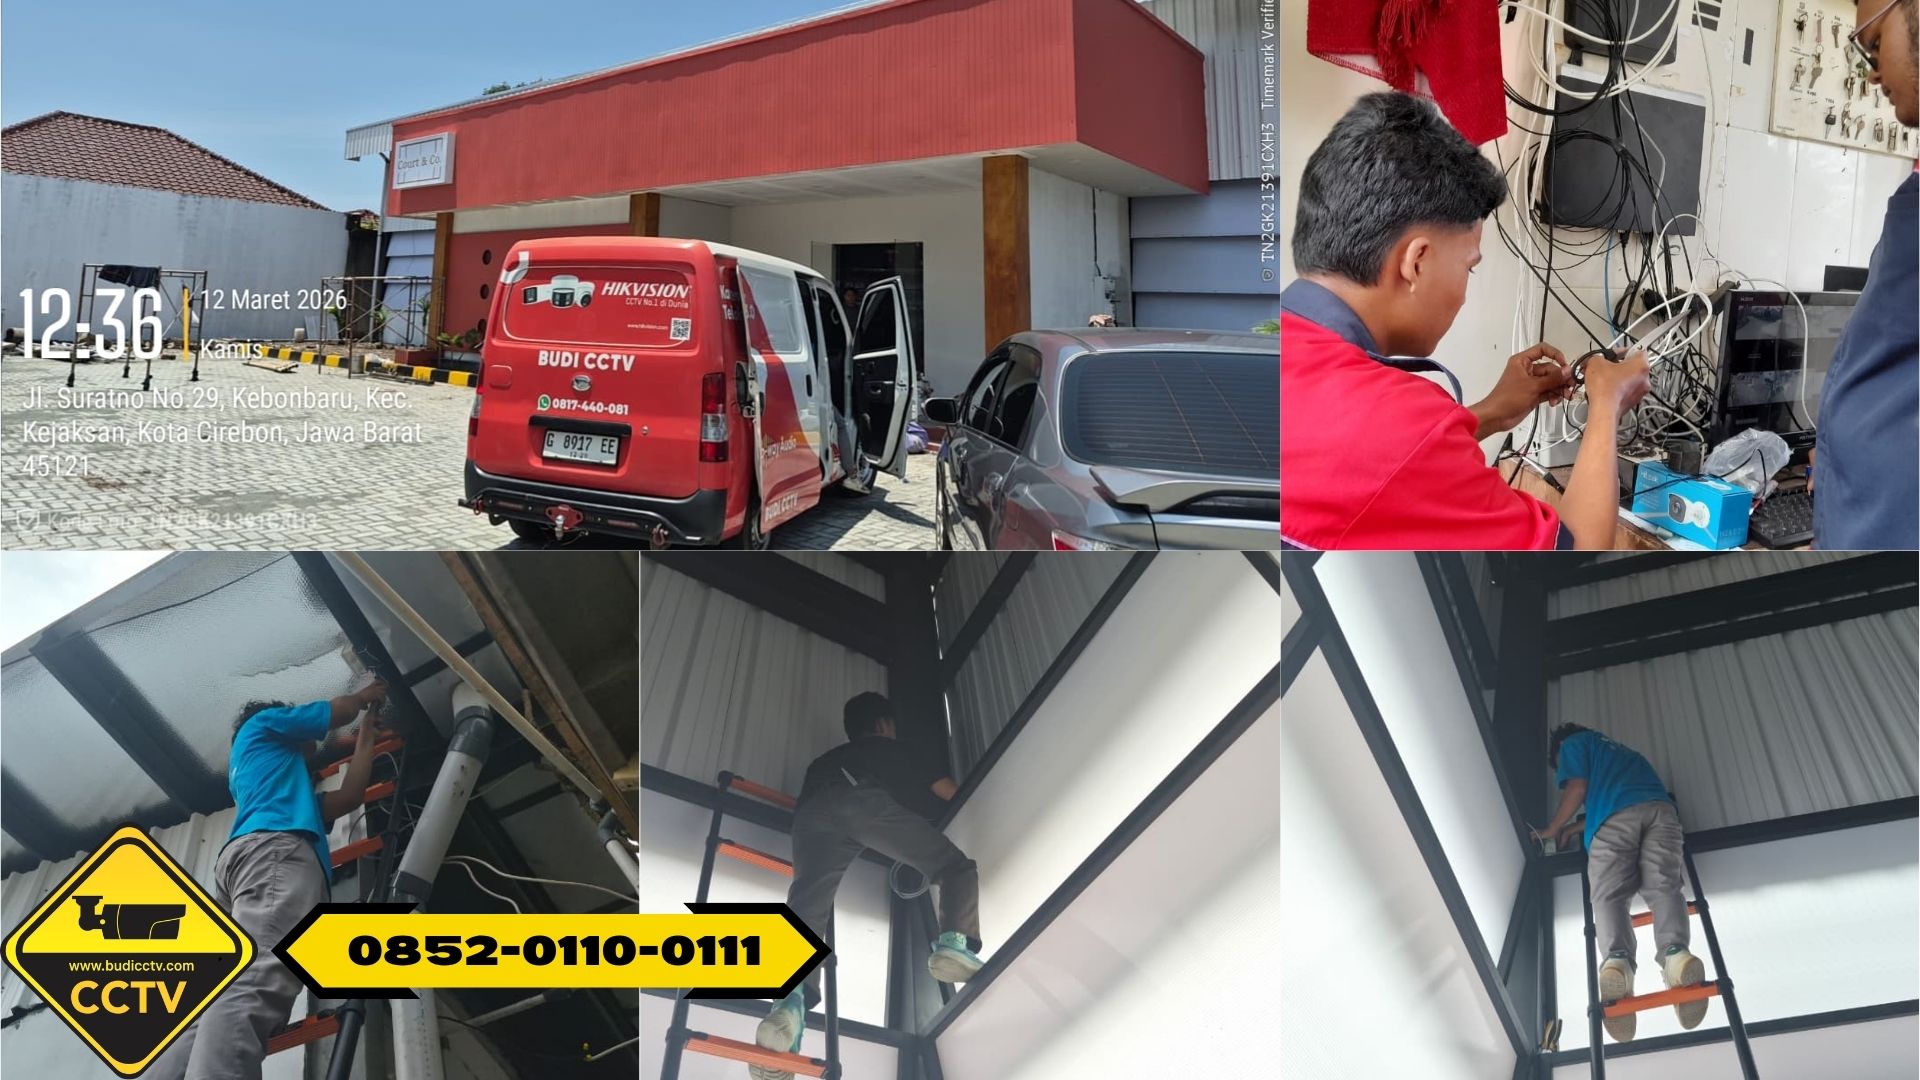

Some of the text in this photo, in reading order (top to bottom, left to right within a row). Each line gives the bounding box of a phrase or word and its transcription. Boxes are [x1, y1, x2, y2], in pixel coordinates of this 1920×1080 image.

[398, 159, 419, 170] Court
[421, 157, 427, 166] &
[601, 282, 689, 299] HIKVISION
[625, 297, 641, 306] CCTV
[643, 299, 658, 307] No.1
[668, 300, 689, 309] Dunia
[538, 350, 636, 372] BUDI CCTV
[552, 398, 629, 415] 0817-440-081
[546, 432, 615, 455] G 8917 EE
